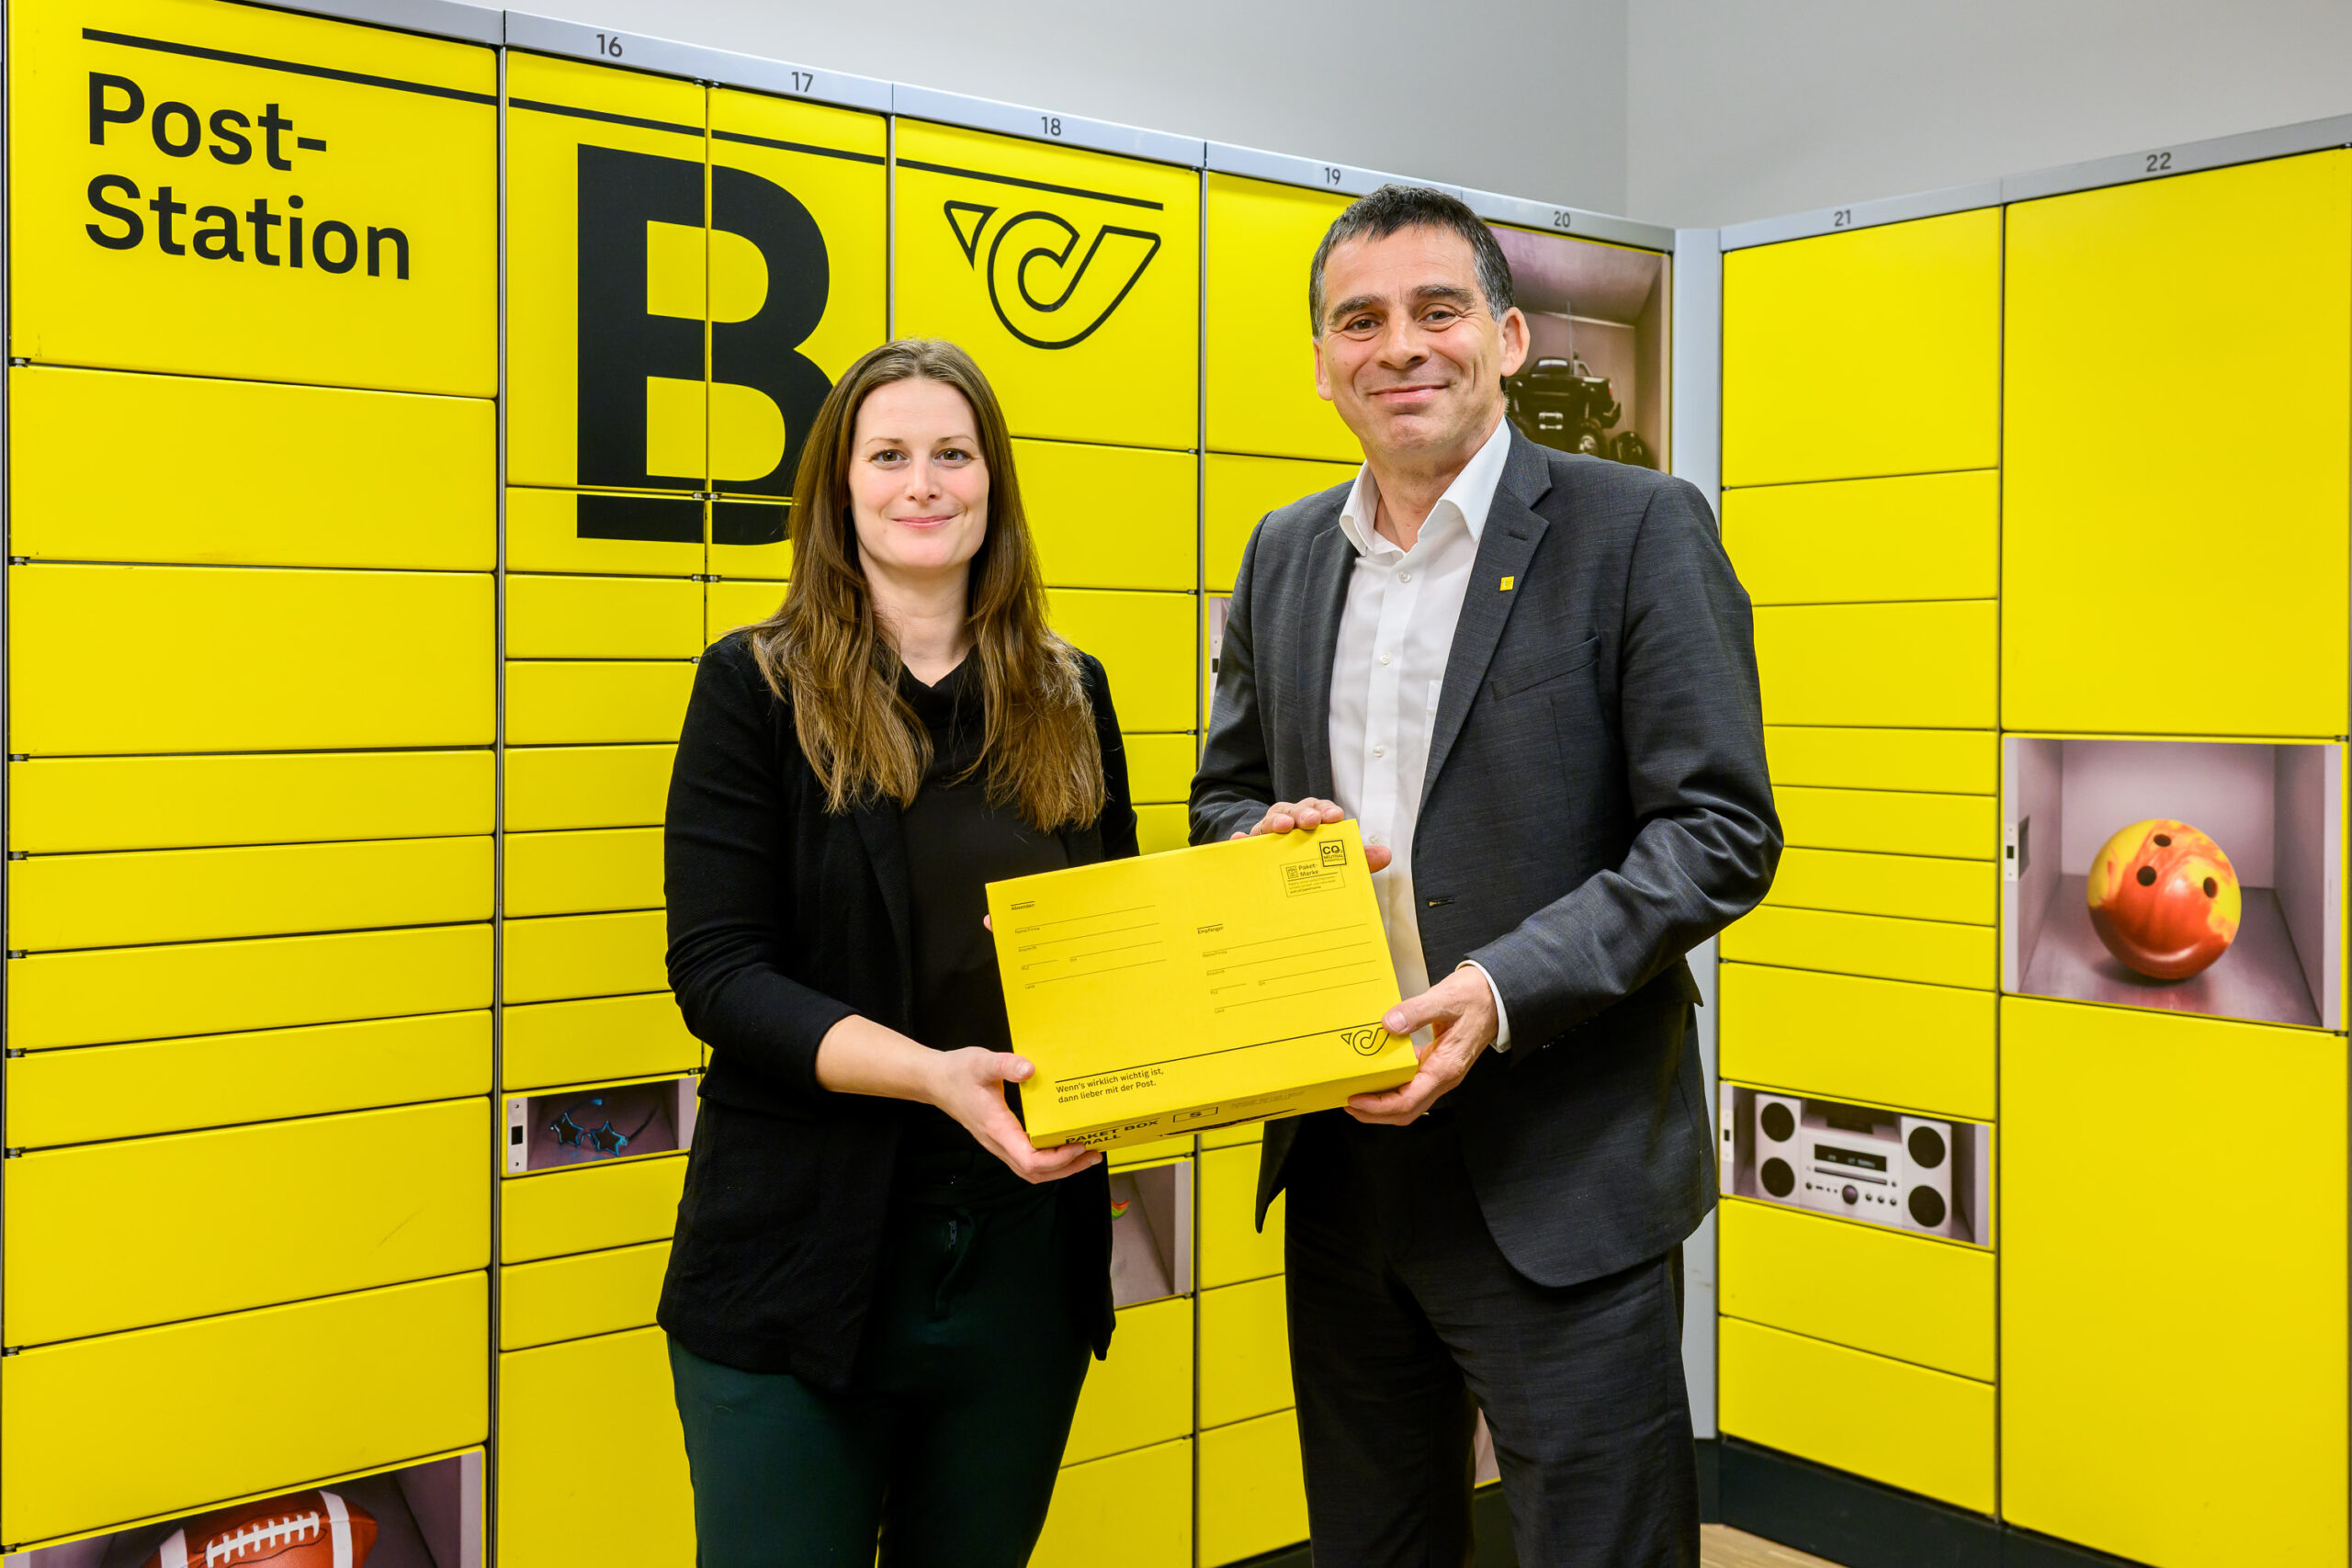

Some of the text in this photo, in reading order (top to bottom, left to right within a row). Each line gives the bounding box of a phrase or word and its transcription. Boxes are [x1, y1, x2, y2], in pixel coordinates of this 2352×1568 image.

[596, 33, 623, 58] 16
[790, 71, 814, 93] 17
[88, 71, 328, 172] Post-
[1040, 116, 1062, 138] 18
[2146, 152, 2172, 173] 22
[1324, 166, 1341, 186] 19
[85, 174, 410, 280] Station
[1554, 210, 1571, 228] 20
[1834, 209, 1851, 227] 21
[577, 142, 834, 546] B
[1056, 1067, 1164, 1094] Wenn's wirklich wichtig ist,
[1057, 1079, 1157, 1104] dann lieber mit der Post.
[1066, 1120, 1159, 1145] PAKET BOX
